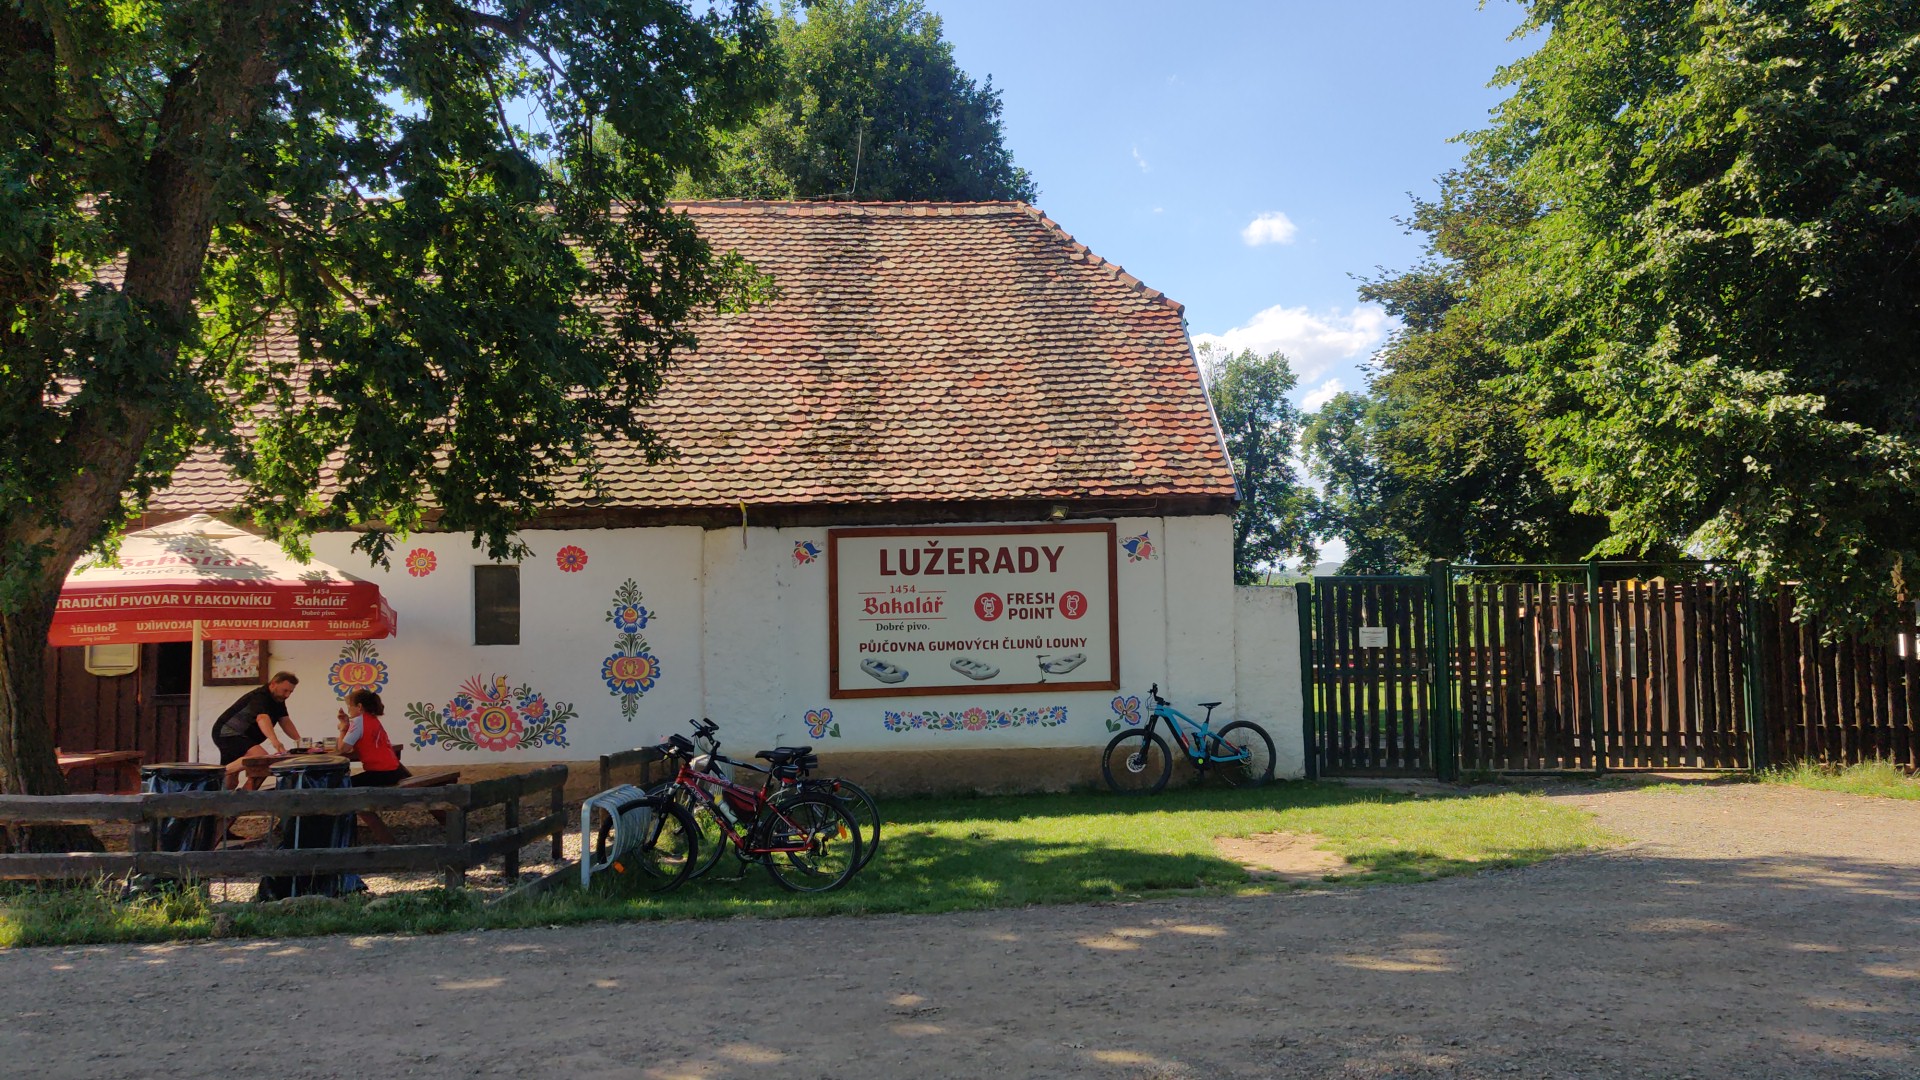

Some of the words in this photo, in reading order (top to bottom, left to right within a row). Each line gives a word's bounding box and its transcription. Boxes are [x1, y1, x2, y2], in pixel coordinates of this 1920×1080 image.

[879, 540, 1065, 576] LUŽERADY
[889, 584, 917, 594] 1454
[55, 594, 118, 609] TRADIČNÍ
[120, 595, 179, 606] PIVOVAR
[182, 595, 191, 605] V
[194, 593, 272, 606] RAKOVNÍKU
[293, 595, 347, 606] Bakalář
[1007, 592, 1055, 605] FRESH
[862, 596, 944, 615] Bakalář
[1008, 607, 1055, 620] POINT
[876, 622, 905, 632] Dobré
[906, 622, 931, 633] pivo.
[859, 639, 925, 653] PŮJČOVNA
[928, 637, 999, 651] GUMOVÝCH
[1002, 635, 1043, 649] ČLUNŮ
[1046, 637, 1088, 649] LOUNY
